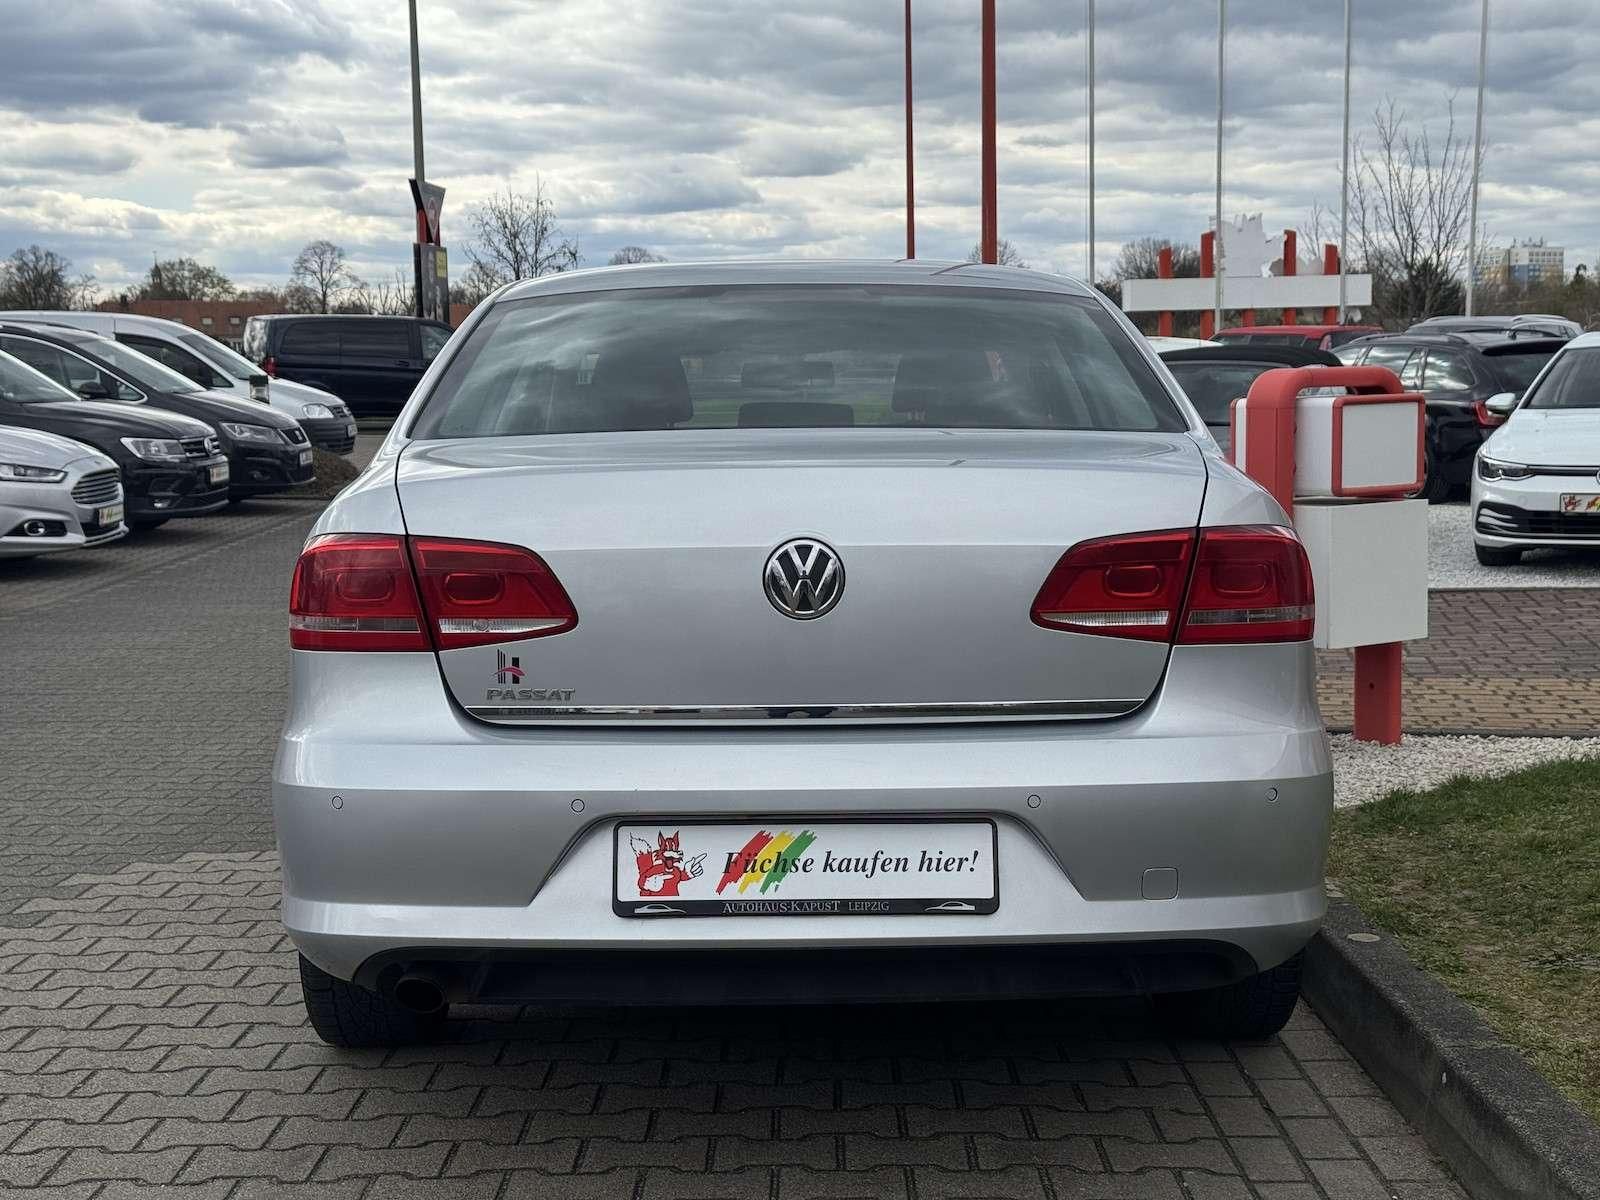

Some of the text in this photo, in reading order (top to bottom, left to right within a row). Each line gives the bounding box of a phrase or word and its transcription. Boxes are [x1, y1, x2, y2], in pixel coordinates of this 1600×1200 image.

[486, 687, 576, 701] PASSAT
[722, 849, 980, 879] Füchse kaufen hier!
[848, 901, 890, 912] LEIPZIG
